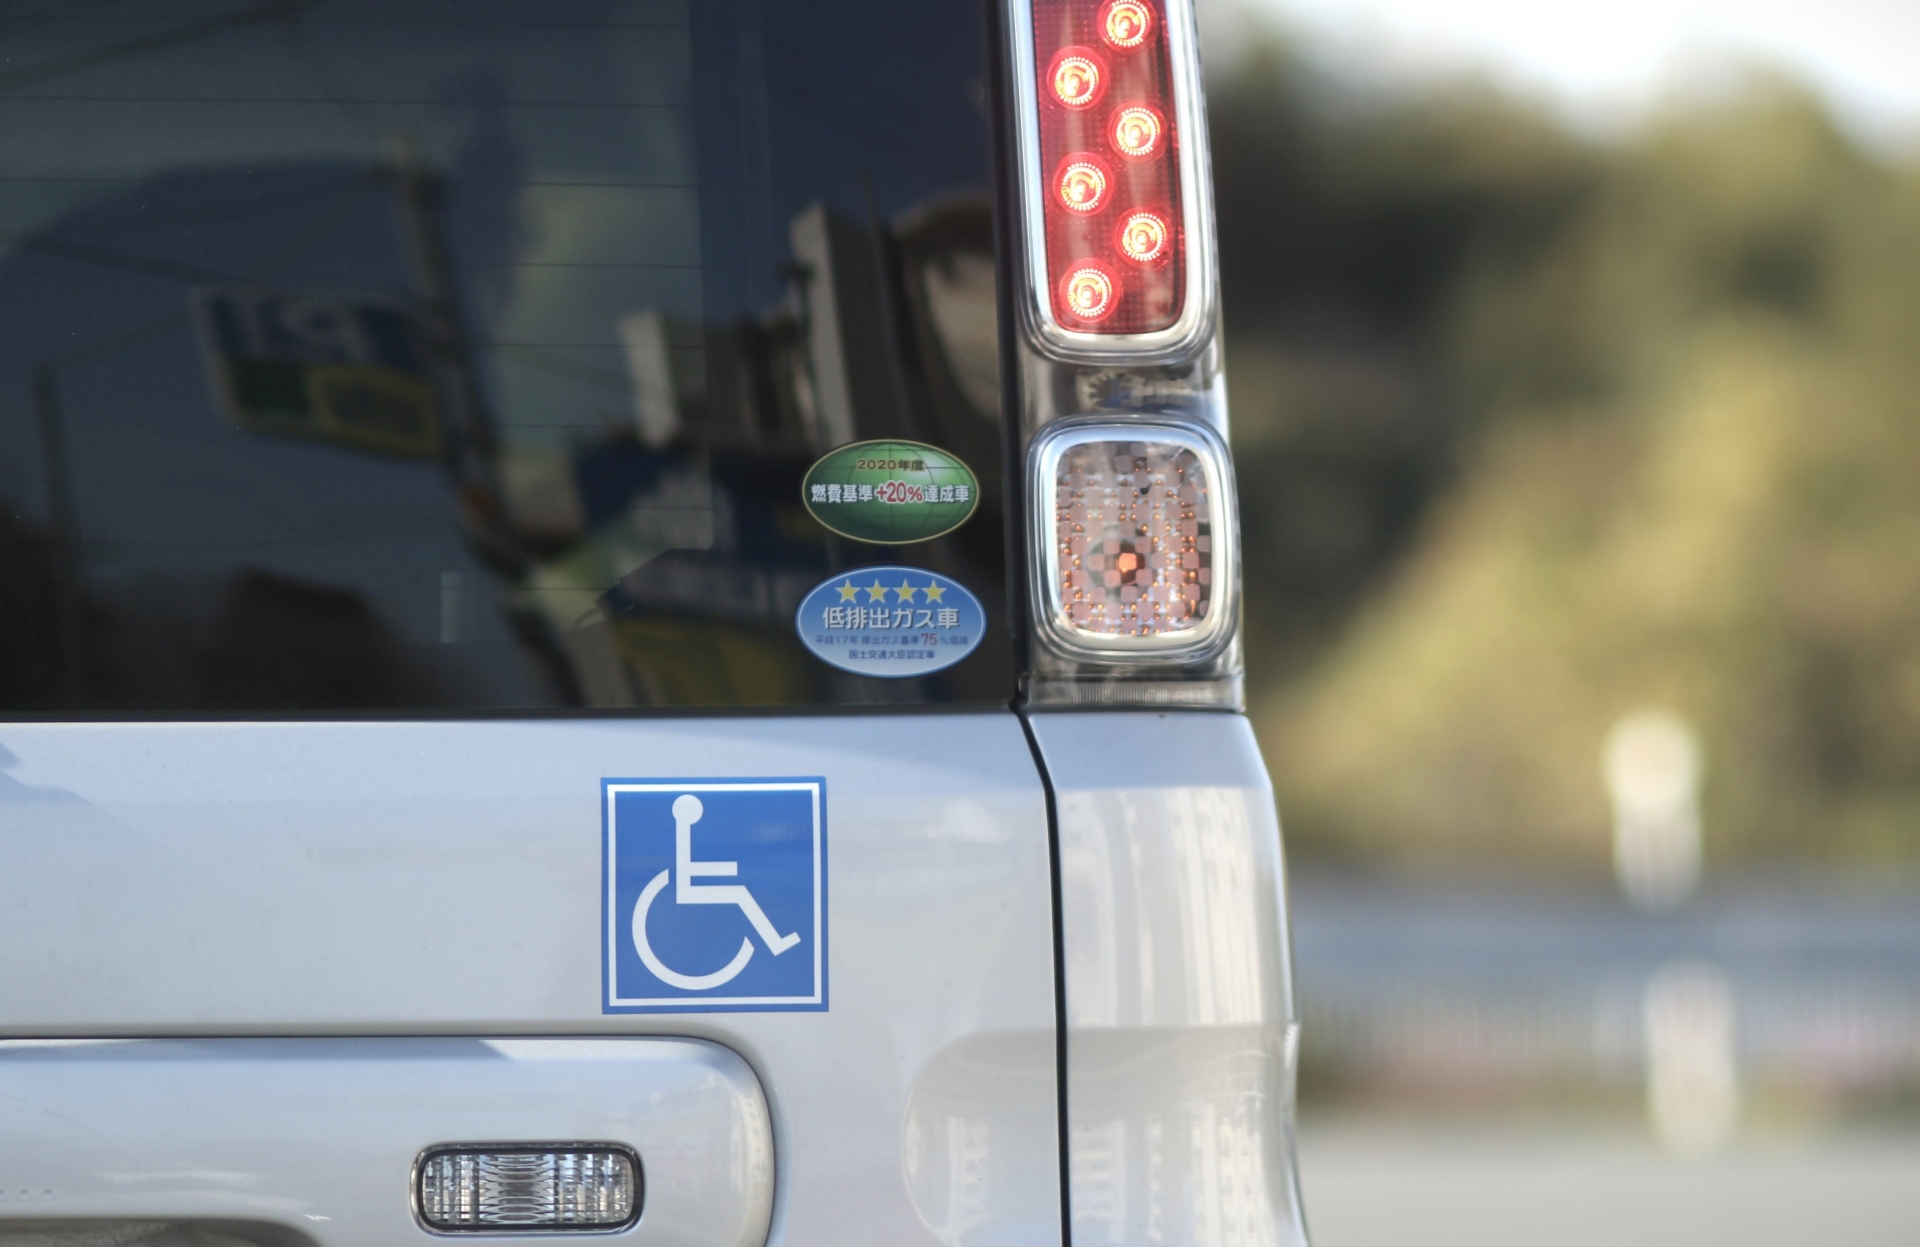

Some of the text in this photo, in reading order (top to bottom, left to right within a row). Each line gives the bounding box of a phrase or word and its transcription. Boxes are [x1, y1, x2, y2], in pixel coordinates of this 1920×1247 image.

[857, 459, 925, 471] 2020年度
[822, 607, 960, 629] 低排出ガス車
